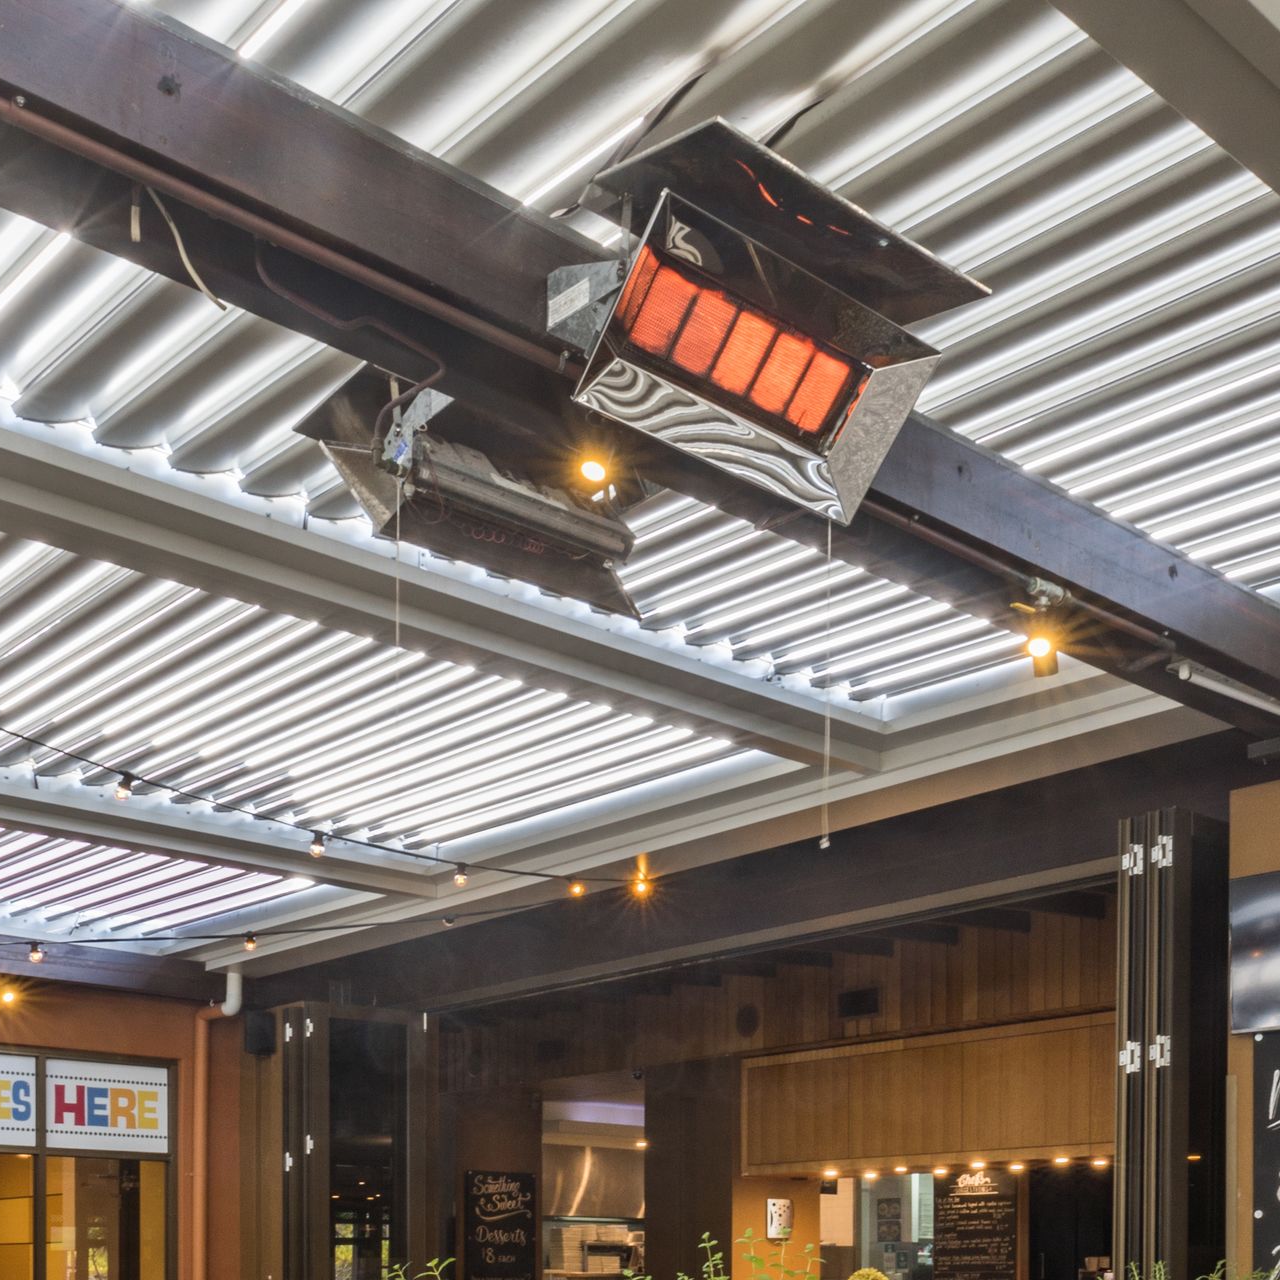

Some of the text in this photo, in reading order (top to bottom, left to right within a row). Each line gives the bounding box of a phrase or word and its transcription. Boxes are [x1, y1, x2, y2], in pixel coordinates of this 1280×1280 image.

[54, 1084, 159, 1130] HERE
[473, 1175, 520, 1196] Something
[480, 1193, 531, 1212] Sweet
[476, 1225, 526, 1247] Desserts
